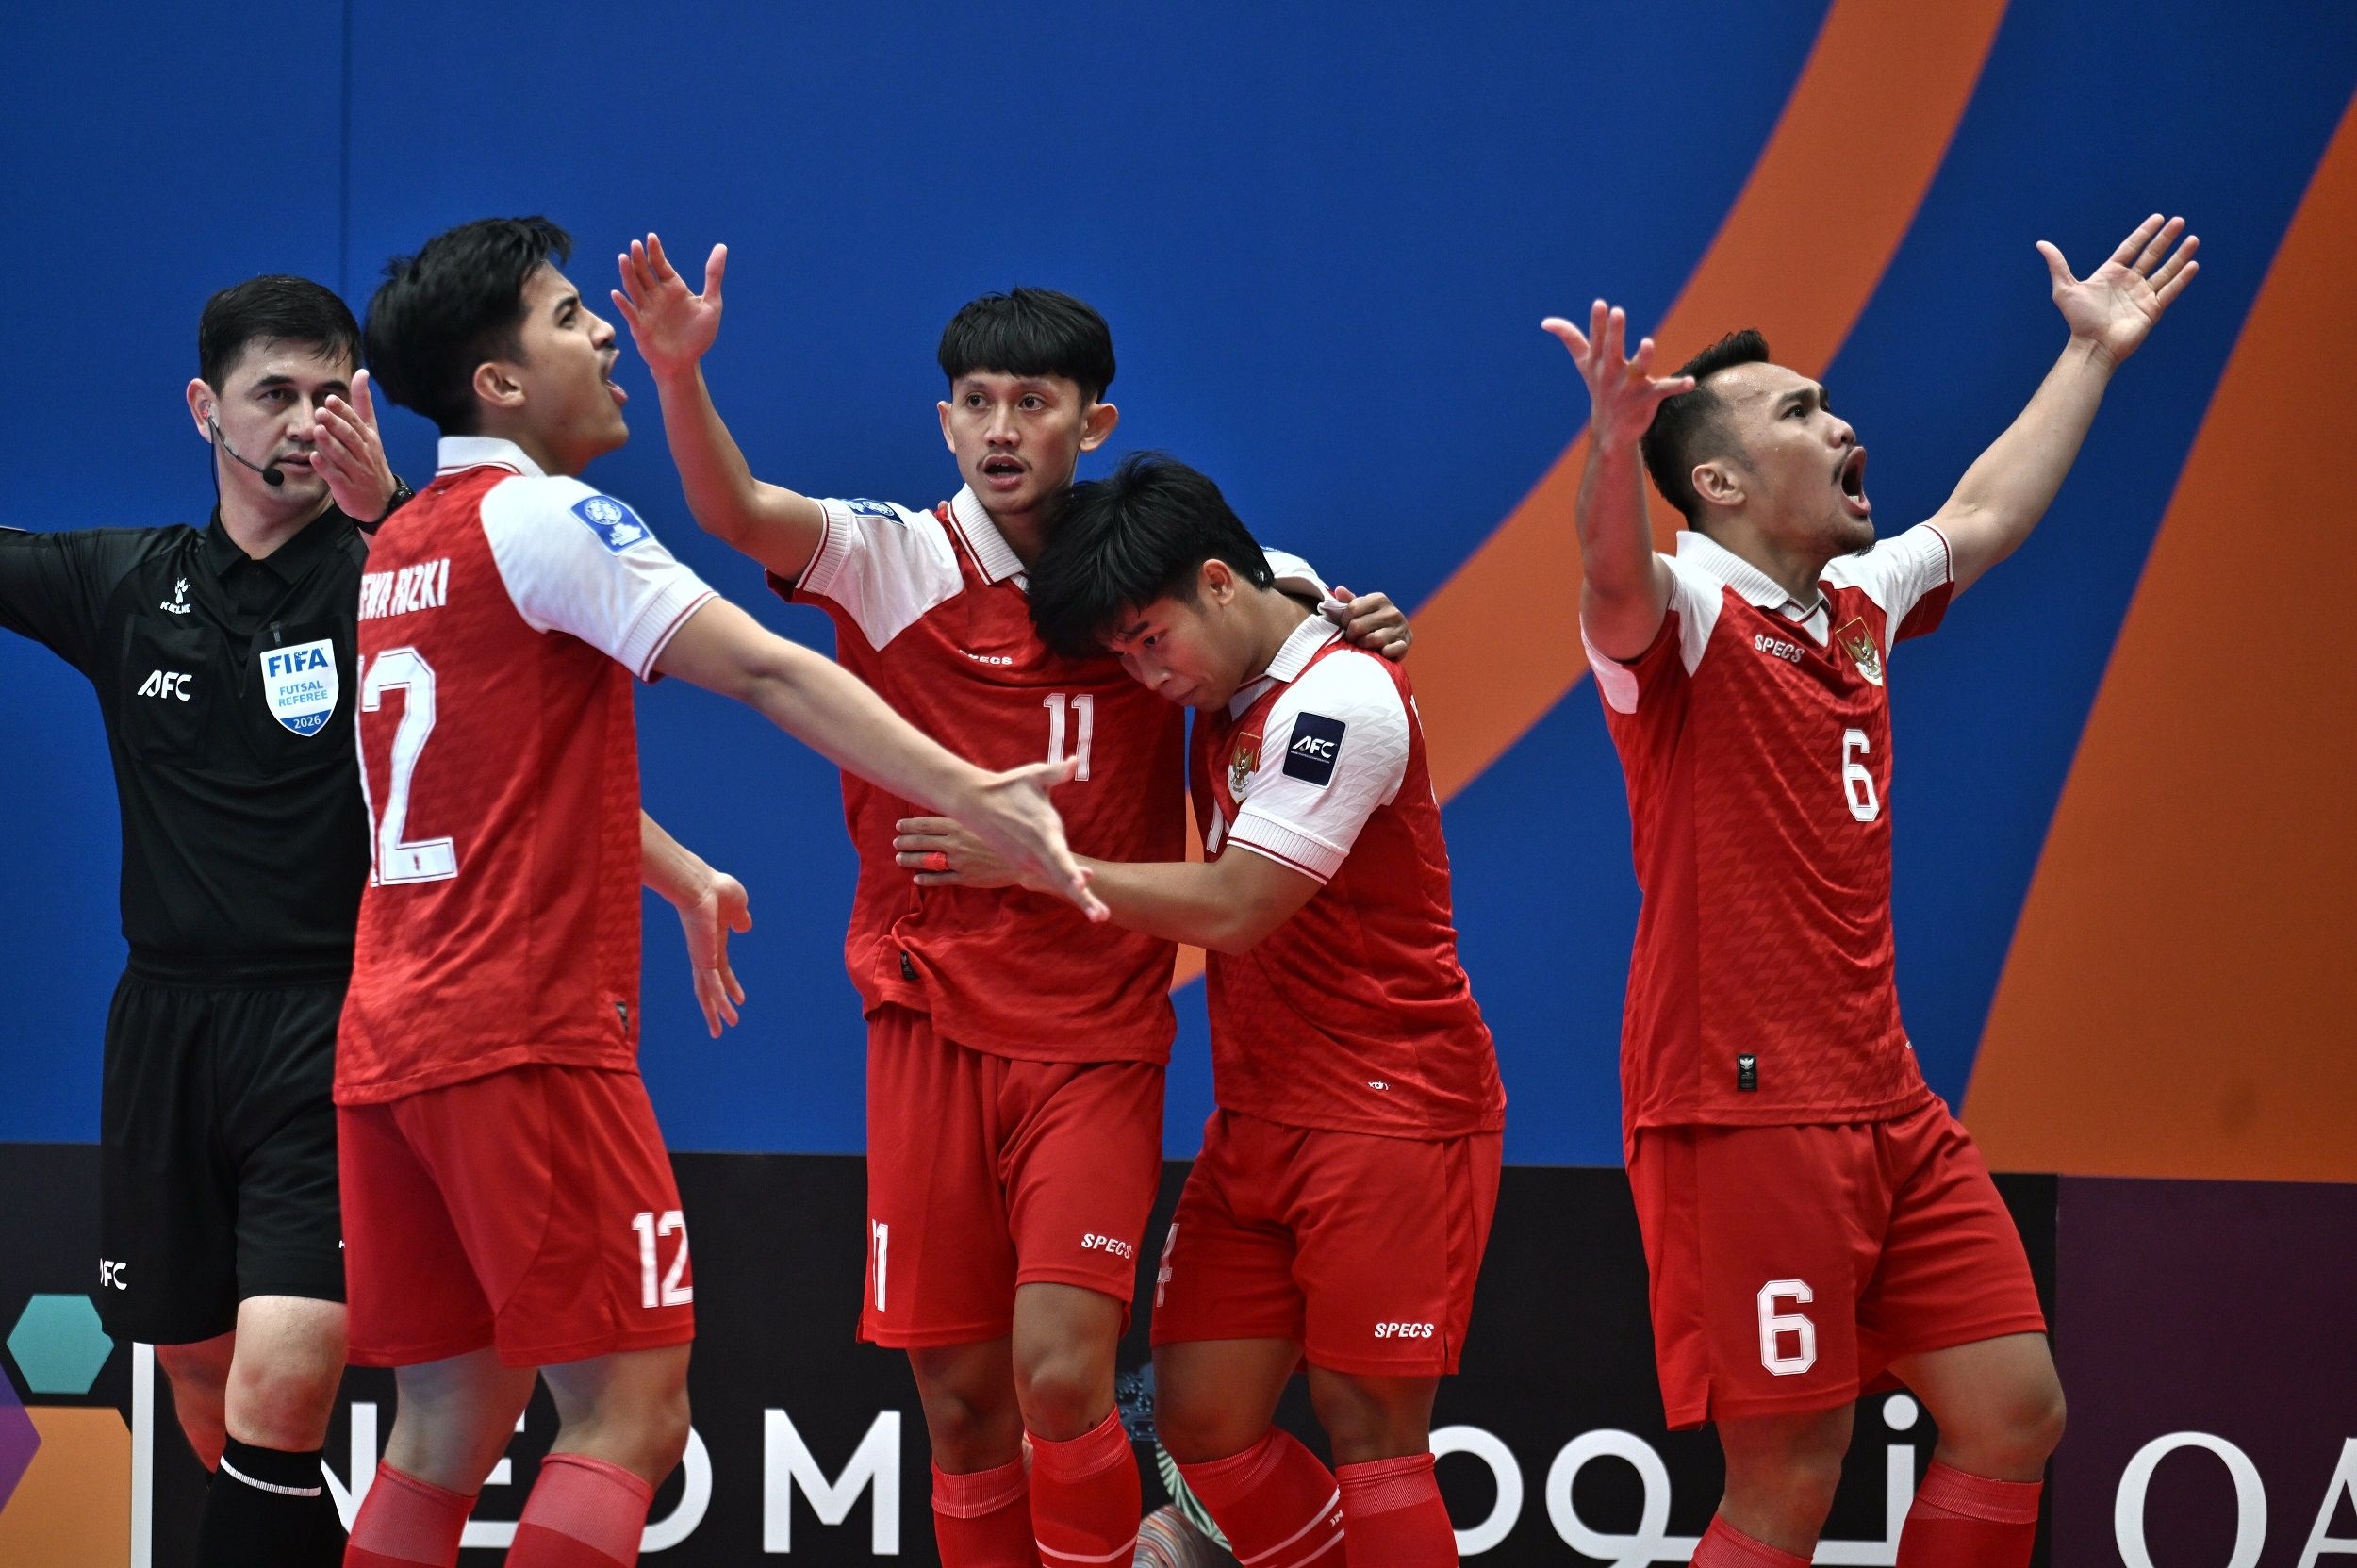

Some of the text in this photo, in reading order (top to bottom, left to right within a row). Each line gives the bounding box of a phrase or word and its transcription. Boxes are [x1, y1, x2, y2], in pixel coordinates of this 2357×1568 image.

[268, 648, 328, 677] FIFA
[1754, 635, 1805, 662] SPECS
[138, 670, 192, 701] AFC
[278, 690, 328, 706] REFEREE
[279, 680, 323, 695] FUTSAL
[293, 715, 321, 729] 2026
[1043, 693, 1093, 781] 11
[1293, 735, 1335, 758] AFC
[355, 647, 458, 887] 2
[1842, 729, 1880, 821] 6
[631, 1210, 694, 1308] 12
[1081, 1233, 1132, 1260] SPECS
[100, 1258, 127, 1290] FC
[872, 1219, 888, 1312] 1
[1374, 1322, 1434, 1339] SPECS
[1757, 1279, 1817, 1377] 6
